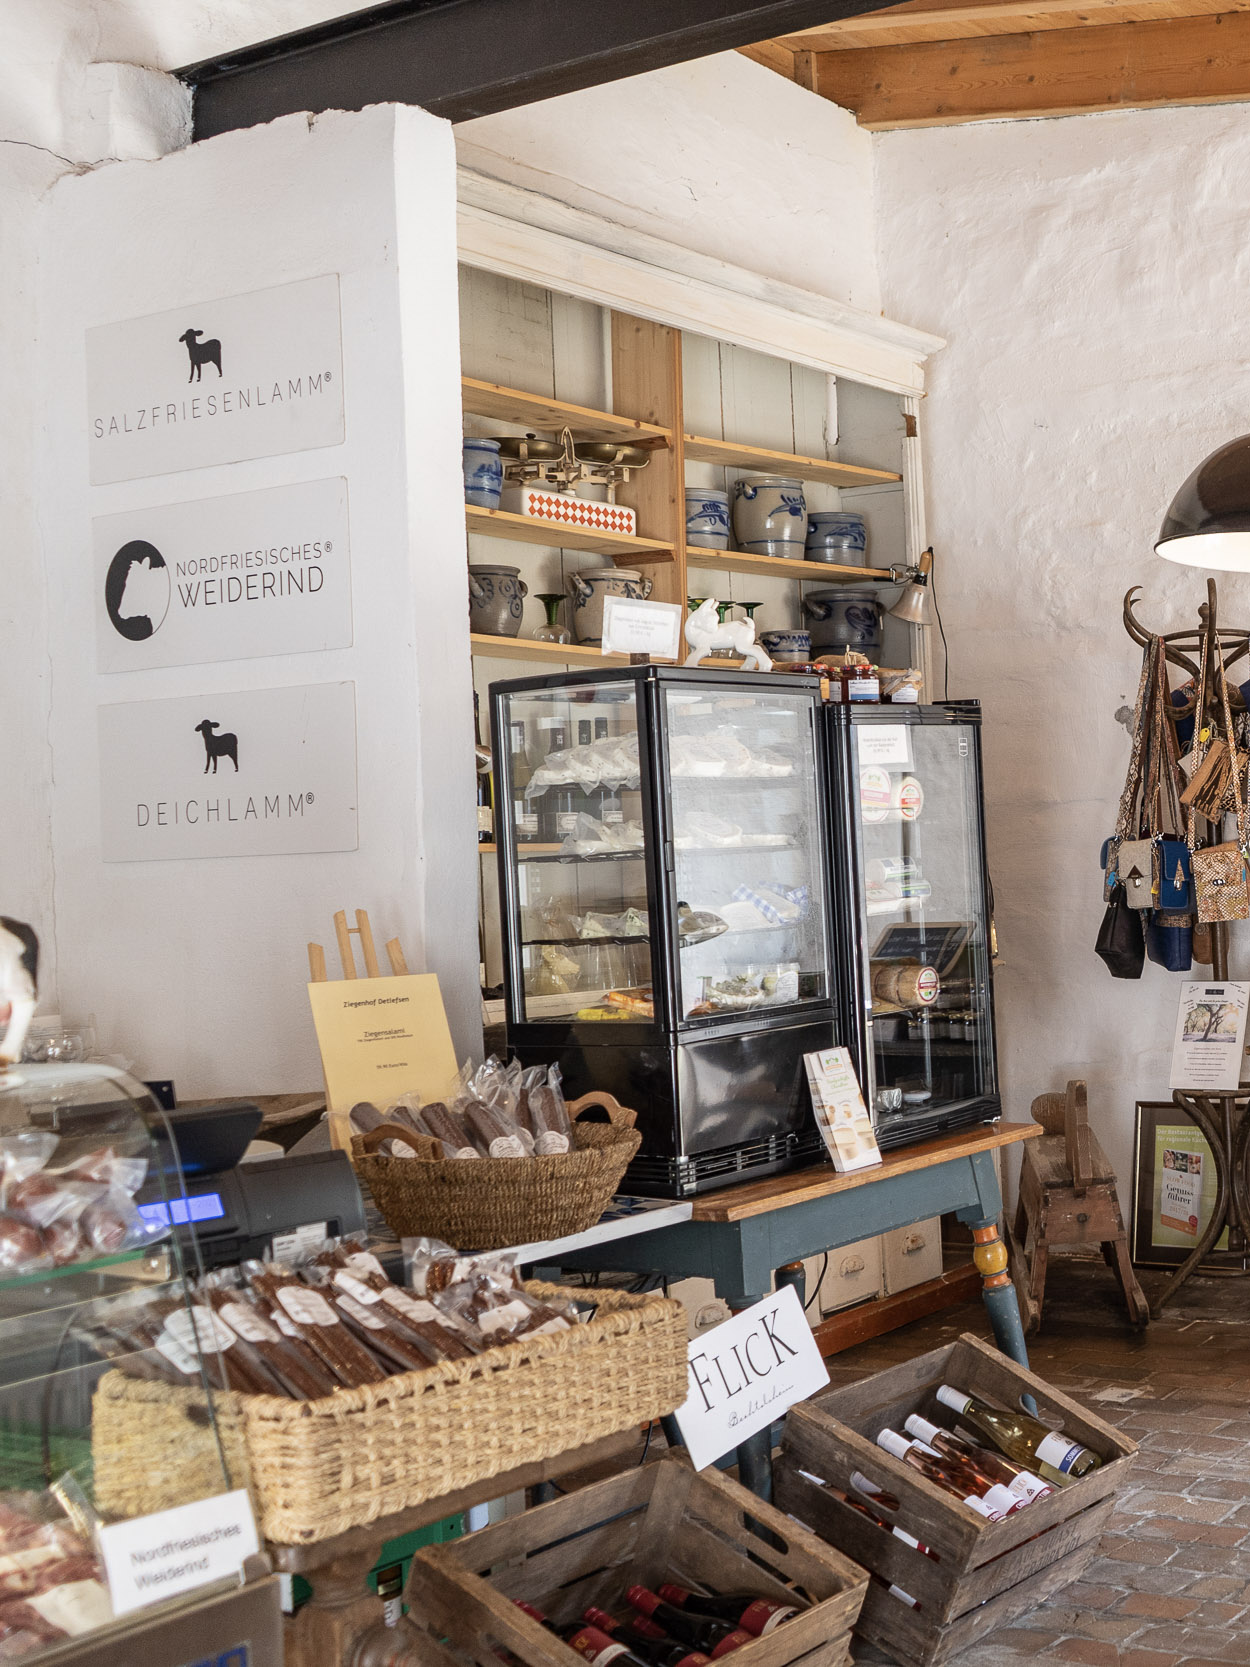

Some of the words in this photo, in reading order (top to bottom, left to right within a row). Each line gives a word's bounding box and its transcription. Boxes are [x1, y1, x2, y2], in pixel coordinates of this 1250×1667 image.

[177, 566, 324, 608] WEIDERIND
[343, 998, 377, 1008] Ziegenhof
[378, 996, 410, 1005] Detlefsen
[1166, 1183, 1194, 1196] Genuss
[1167, 1192, 1192, 1204] führer
[689, 1308, 799, 1413] FLICK
